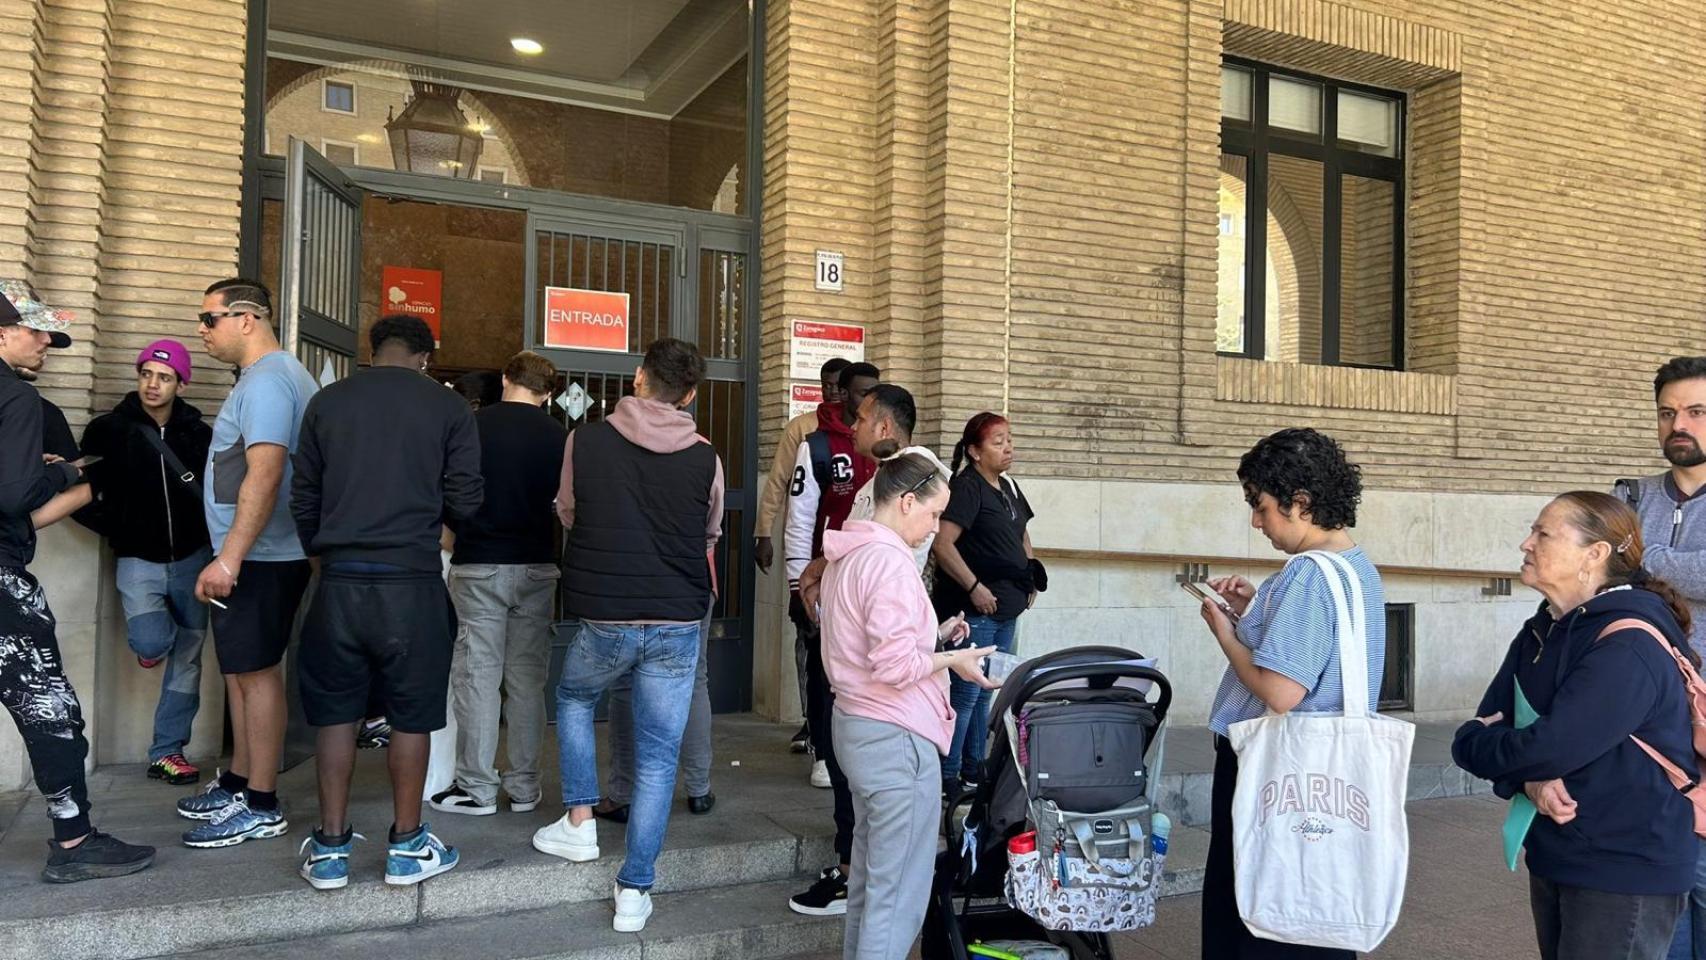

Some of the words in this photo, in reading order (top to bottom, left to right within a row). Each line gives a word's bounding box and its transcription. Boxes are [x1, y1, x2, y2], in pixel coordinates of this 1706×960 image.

[820, 261, 839, 283] 18
[550, 308, 625, 328] ENTRADA
[799, 340, 829, 349] REGISTRO
[830, 343, 857, 351] GENERAL
[1258, 772, 1370, 832] PARIS
